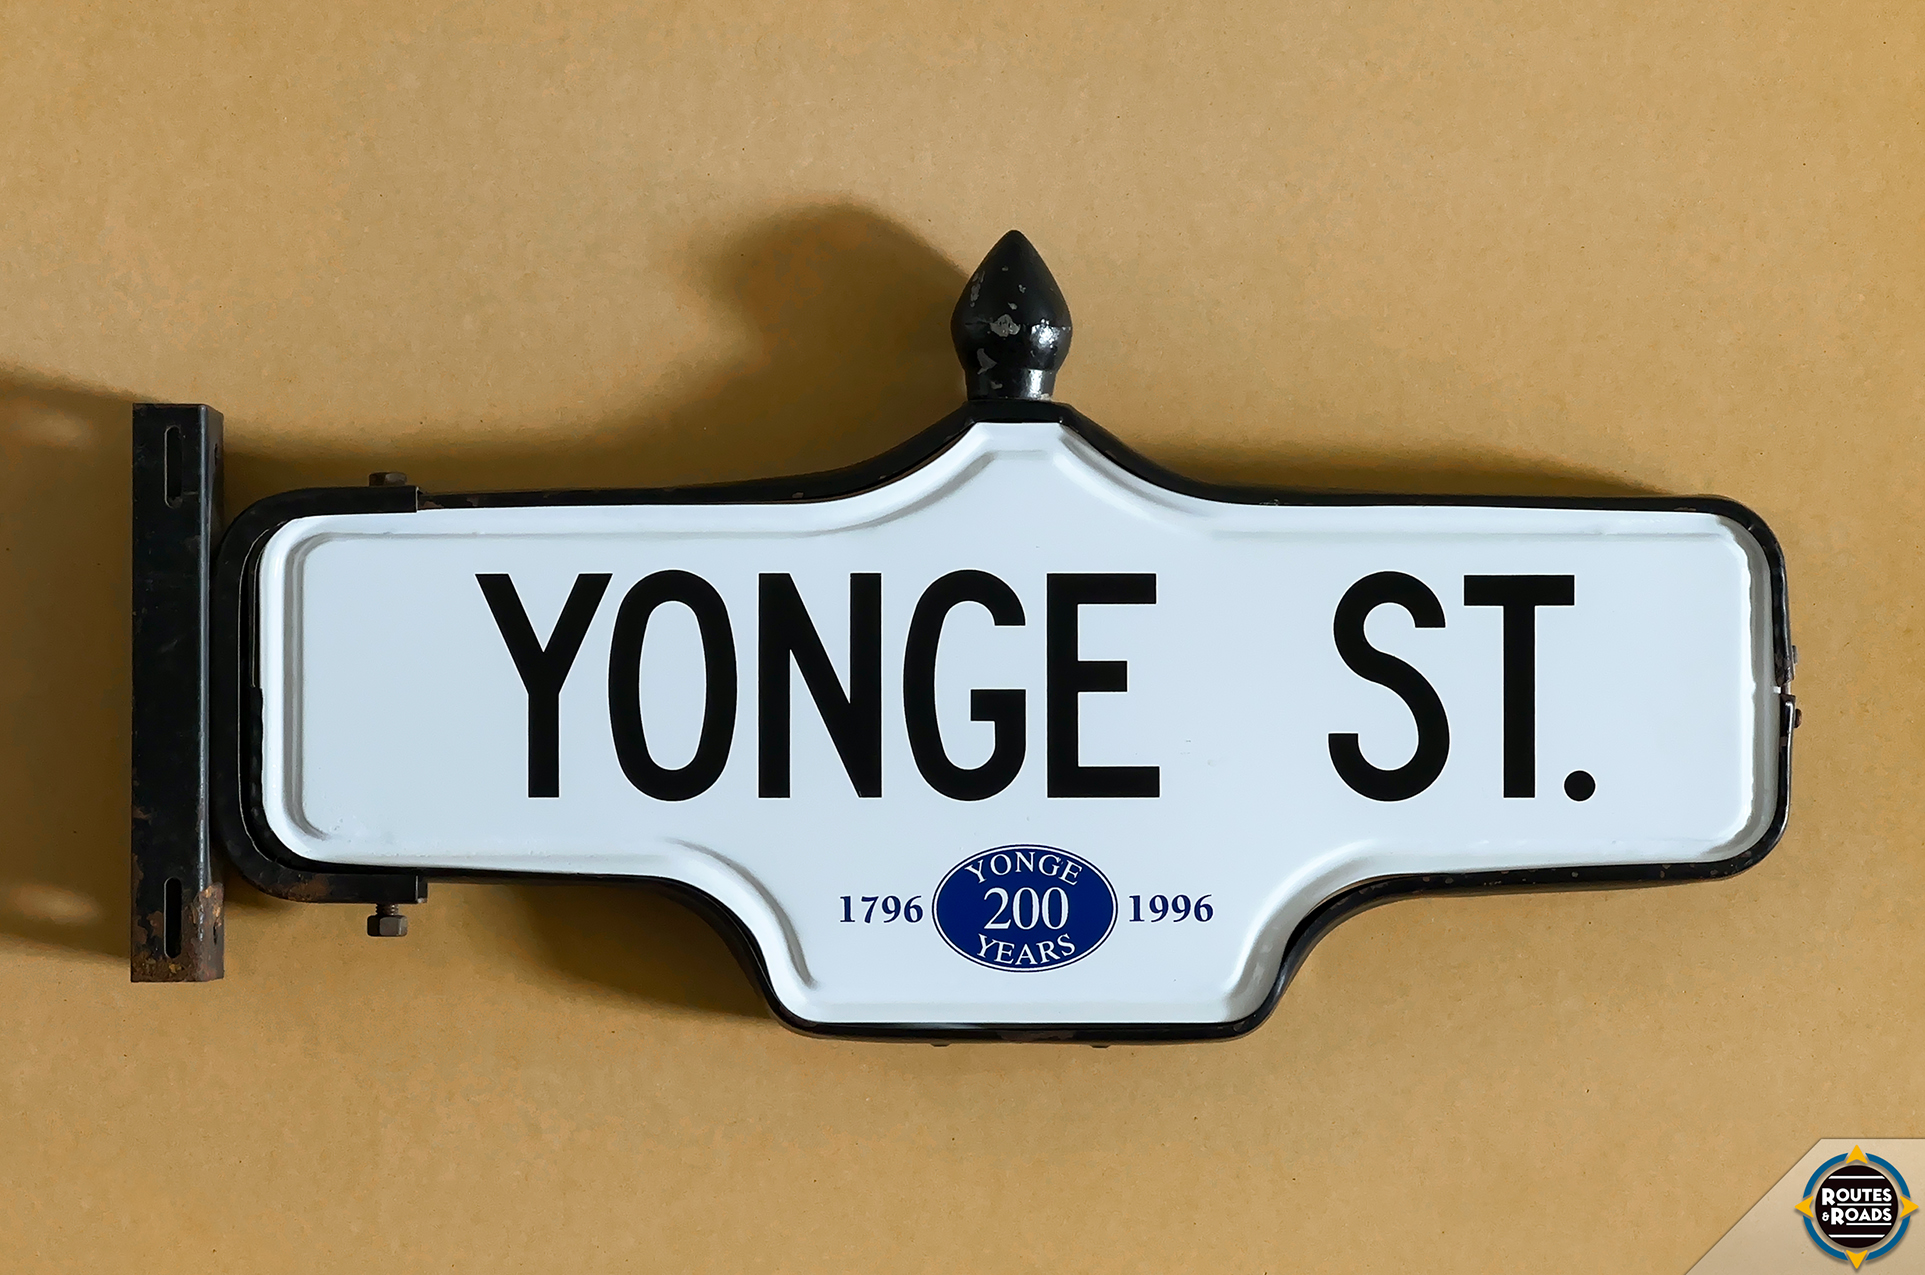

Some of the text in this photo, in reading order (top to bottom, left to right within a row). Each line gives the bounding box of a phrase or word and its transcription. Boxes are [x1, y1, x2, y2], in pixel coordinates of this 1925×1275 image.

[476, 569, 1597, 801] YONGE ST.
[965, 851, 1083, 886] YONGE
[839, 894, 923, 924] 1796
[983, 887, 1069, 931] 200
[1128, 894, 1214, 923] 1996
[975, 933, 1076, 965] YEARS
